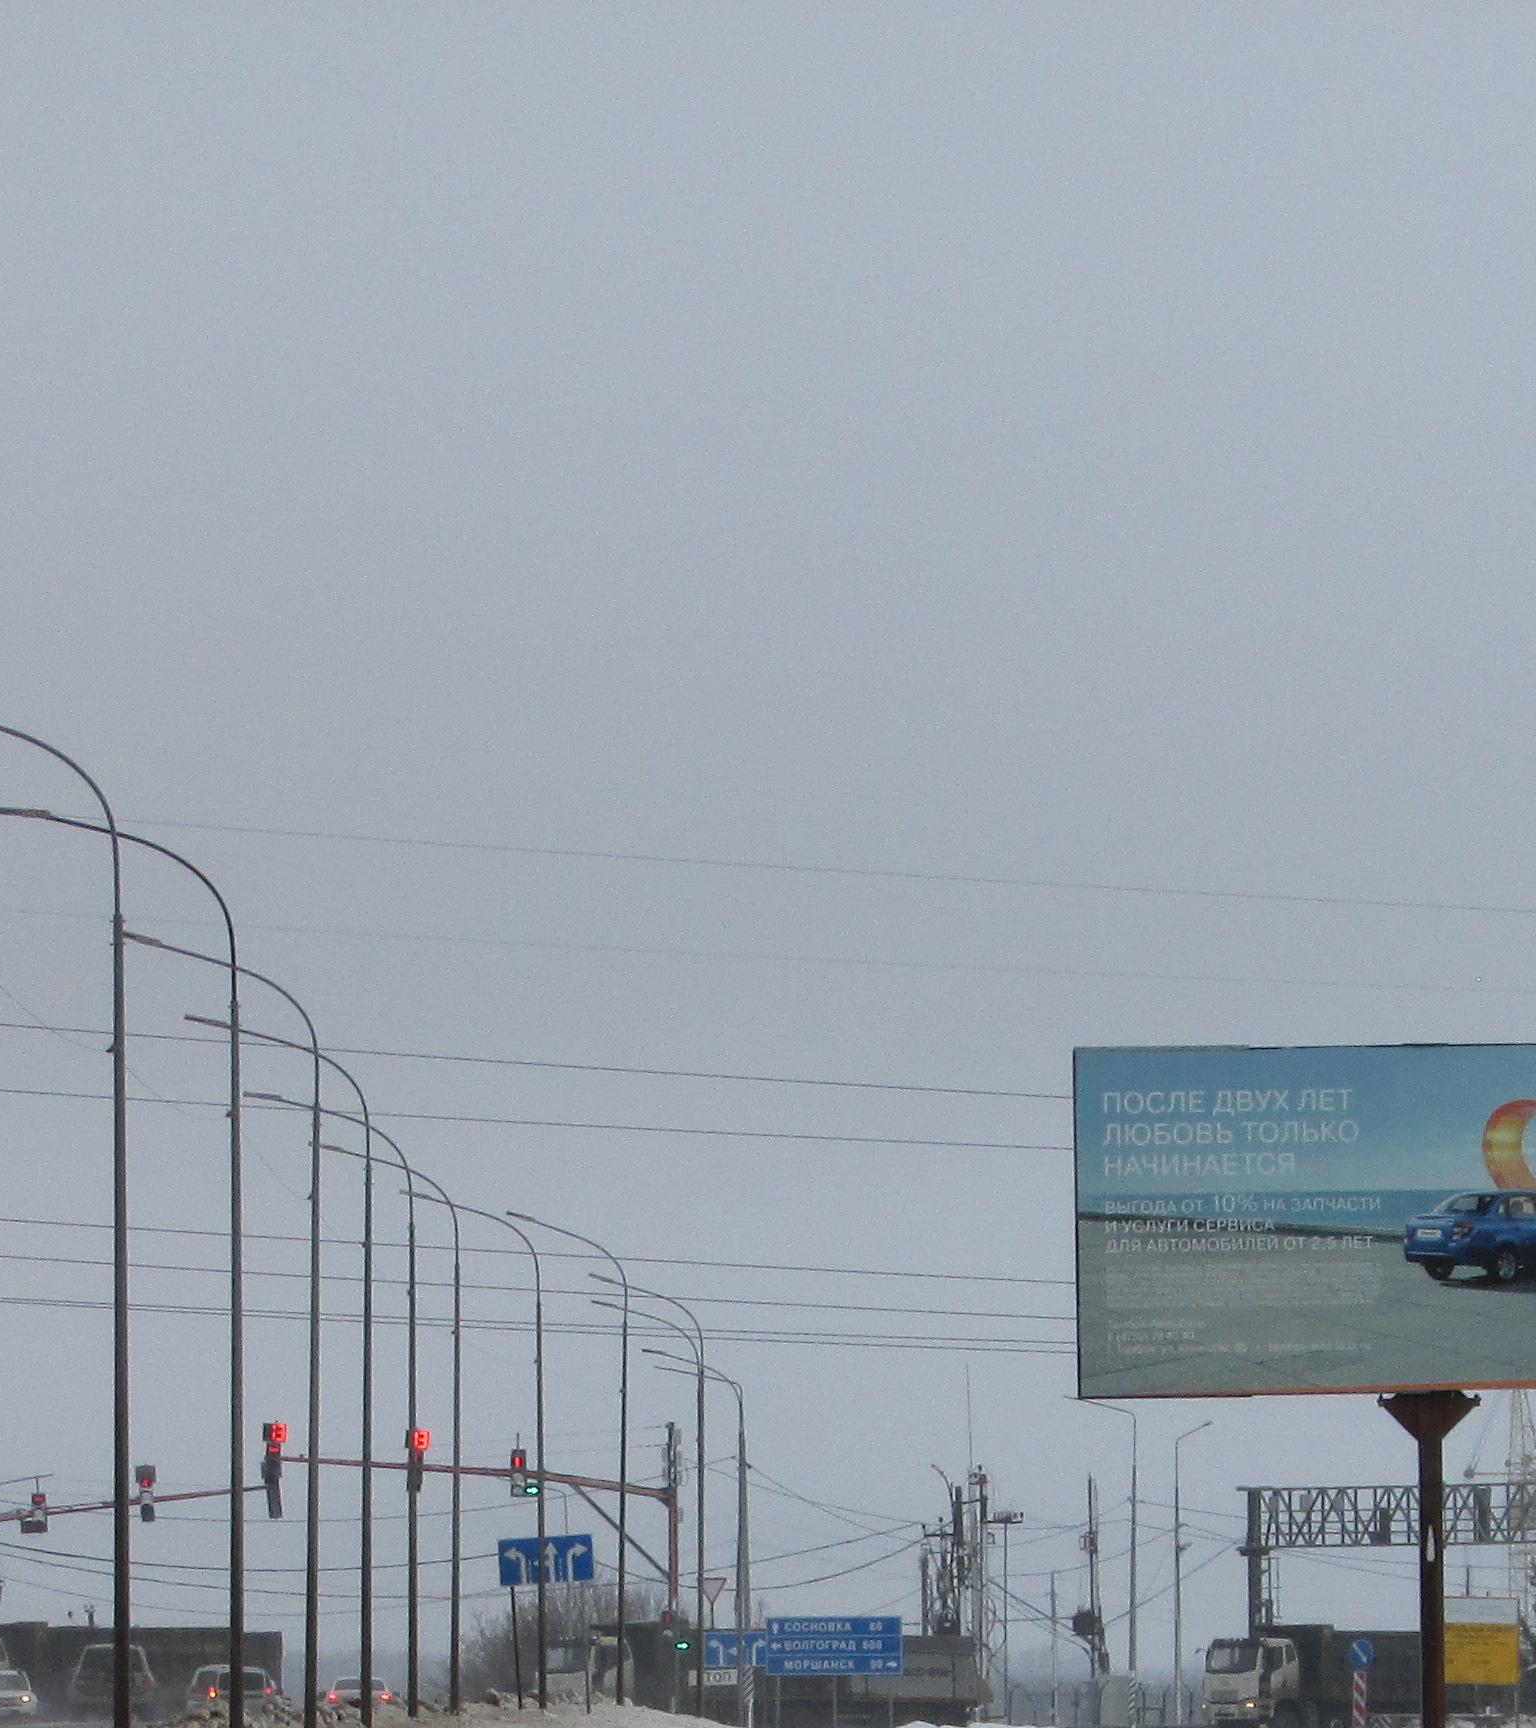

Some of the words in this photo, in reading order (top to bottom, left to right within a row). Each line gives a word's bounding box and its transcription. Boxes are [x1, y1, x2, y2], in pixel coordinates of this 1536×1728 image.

[1103, 1091, 1205, 1114] ПОСЛЕ
[1213, 1088, 1290, 1116] ДВУХ
[1297, 1088, 1353, 1112] ЛЕТ
[1103, 1122, 1233, 1146] ЛЮБОВЬ
[1241, 1120, 1359, 1143] ТОЛЬКО
[1104, 1152, 1296, 1176] НАЧИНАЕТСЯ
[1104, 1200, 1177, 1215] ВЫГОДА
[1181, 1200, 1203, 1213] ОТ
[1214, 1194, 1257, 1213] 10%
[1264, 1197, 1288, 1211] НА
[1291, 1196, 1382, 1211] ЗАПЧАСТИ
[1120, 1219, 1189, 1233] УСЛУГИ
[1194, 1217, 1276, 1232] СЕРВИСА
[1104, 1239, 1142, 1254] ДЛЯ
[1146, 1236, 1279, 1252] АВТОМОБИЛЕЙ
[1283, 1237, 1306, 1251] ОТ
[784, 1622, 852, 1632] СОСНОВКА
[783, 1640, 857, 1652] ВОЛГОГРАД
[784, 1660, 856, 1670] МОРШАНСК
